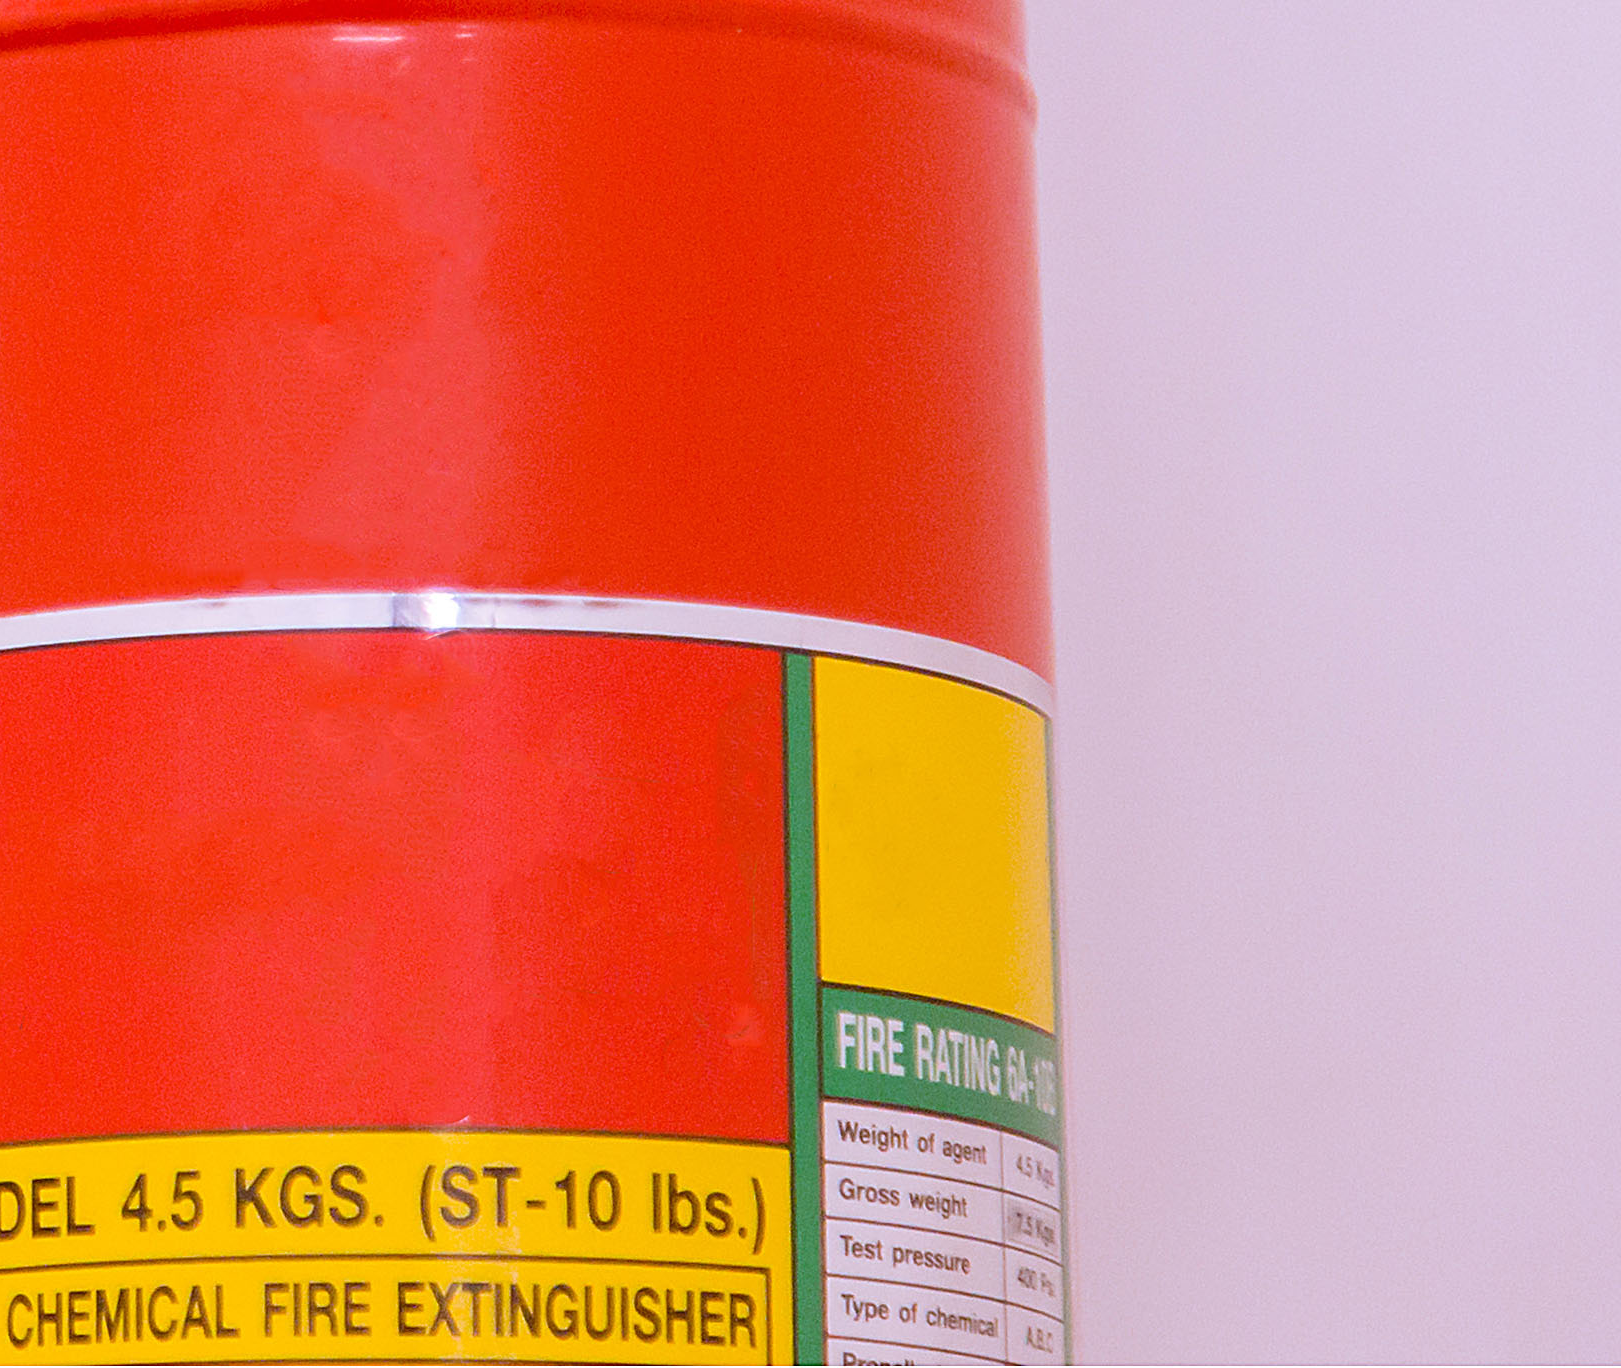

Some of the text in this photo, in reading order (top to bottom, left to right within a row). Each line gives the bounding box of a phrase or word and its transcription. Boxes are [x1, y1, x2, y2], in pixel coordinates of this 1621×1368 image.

[837, 1010, 905, 1077] FIRE
[915, 1023, 1001, 1096] RATING
[837, 1120, 987, 1165] Weight of agent
[121, 1169, 204, 1233] 4.5
[234, 1164, 385, 1232] KGS.
[419, 1163, 622, 1241] (ST-10
[652, 1171, 767, 1255] lbs.)
[839, 1178, 968, 1220] Gross weight
[840, 1234, 971, 1275] Test pressure
[6, 1284, 242, 1347] CHEMICAL
[264, 1281, 371, 1335] FIRE
[396, 1281, 758, 1349] EXTINGUISHER
[841, 1293, 999, 1338] Type of chemical
